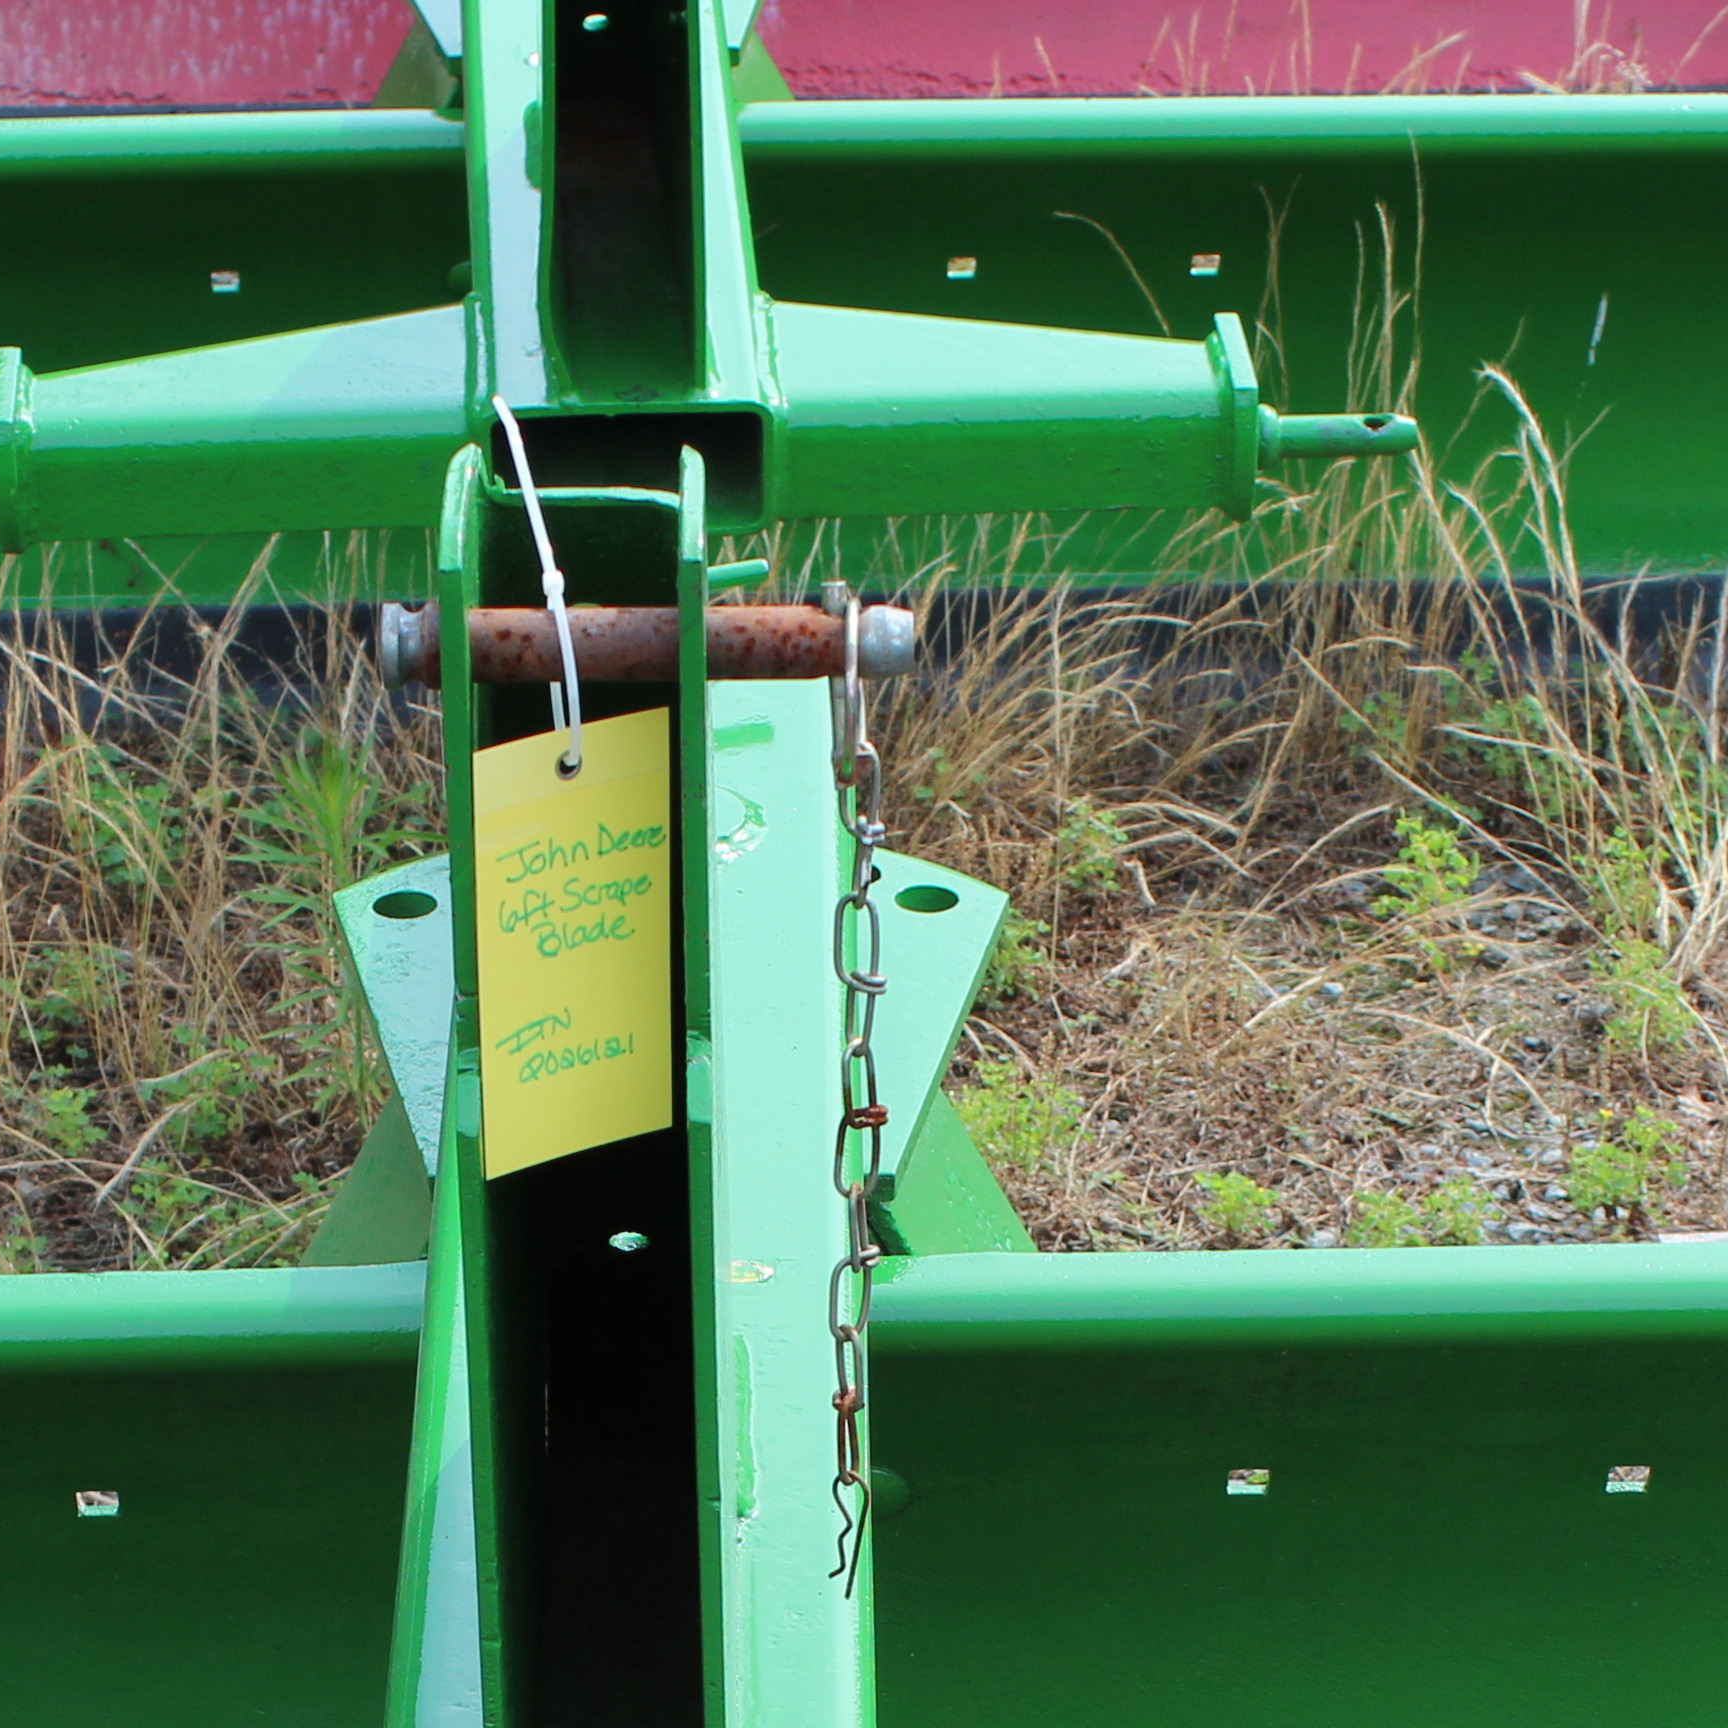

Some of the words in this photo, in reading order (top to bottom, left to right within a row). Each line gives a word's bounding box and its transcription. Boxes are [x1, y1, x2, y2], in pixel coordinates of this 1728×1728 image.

[496, 838, 589, 883] John
[598, 822, 667, 857] Deere
[559, 876, 652, 912] Scrape
[530, 915, 636, 958] Blade
